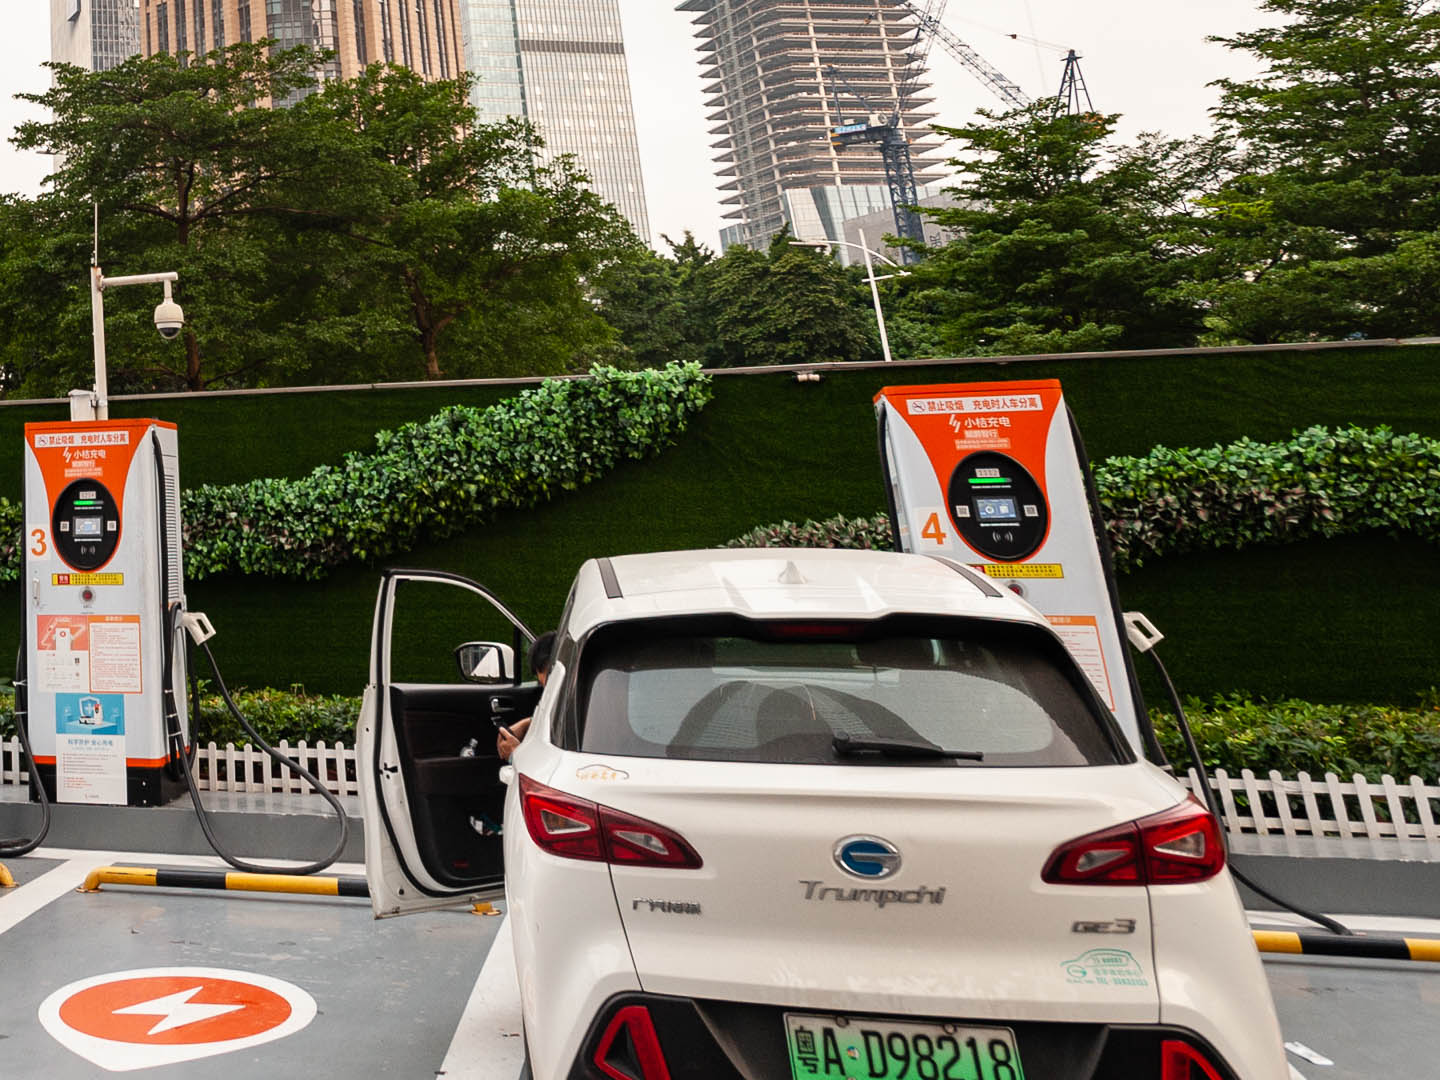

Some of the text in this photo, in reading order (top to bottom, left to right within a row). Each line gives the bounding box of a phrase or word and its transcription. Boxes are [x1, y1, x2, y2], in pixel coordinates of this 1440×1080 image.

[972, 397, 1038, 410] 充电时人车分离
[30, 528, 47, 556] 3
[921, 512, 947, 545] 4
[798, 879, 946, 909] Trumpchi
[1071, 918, 1136, 934] GE3
